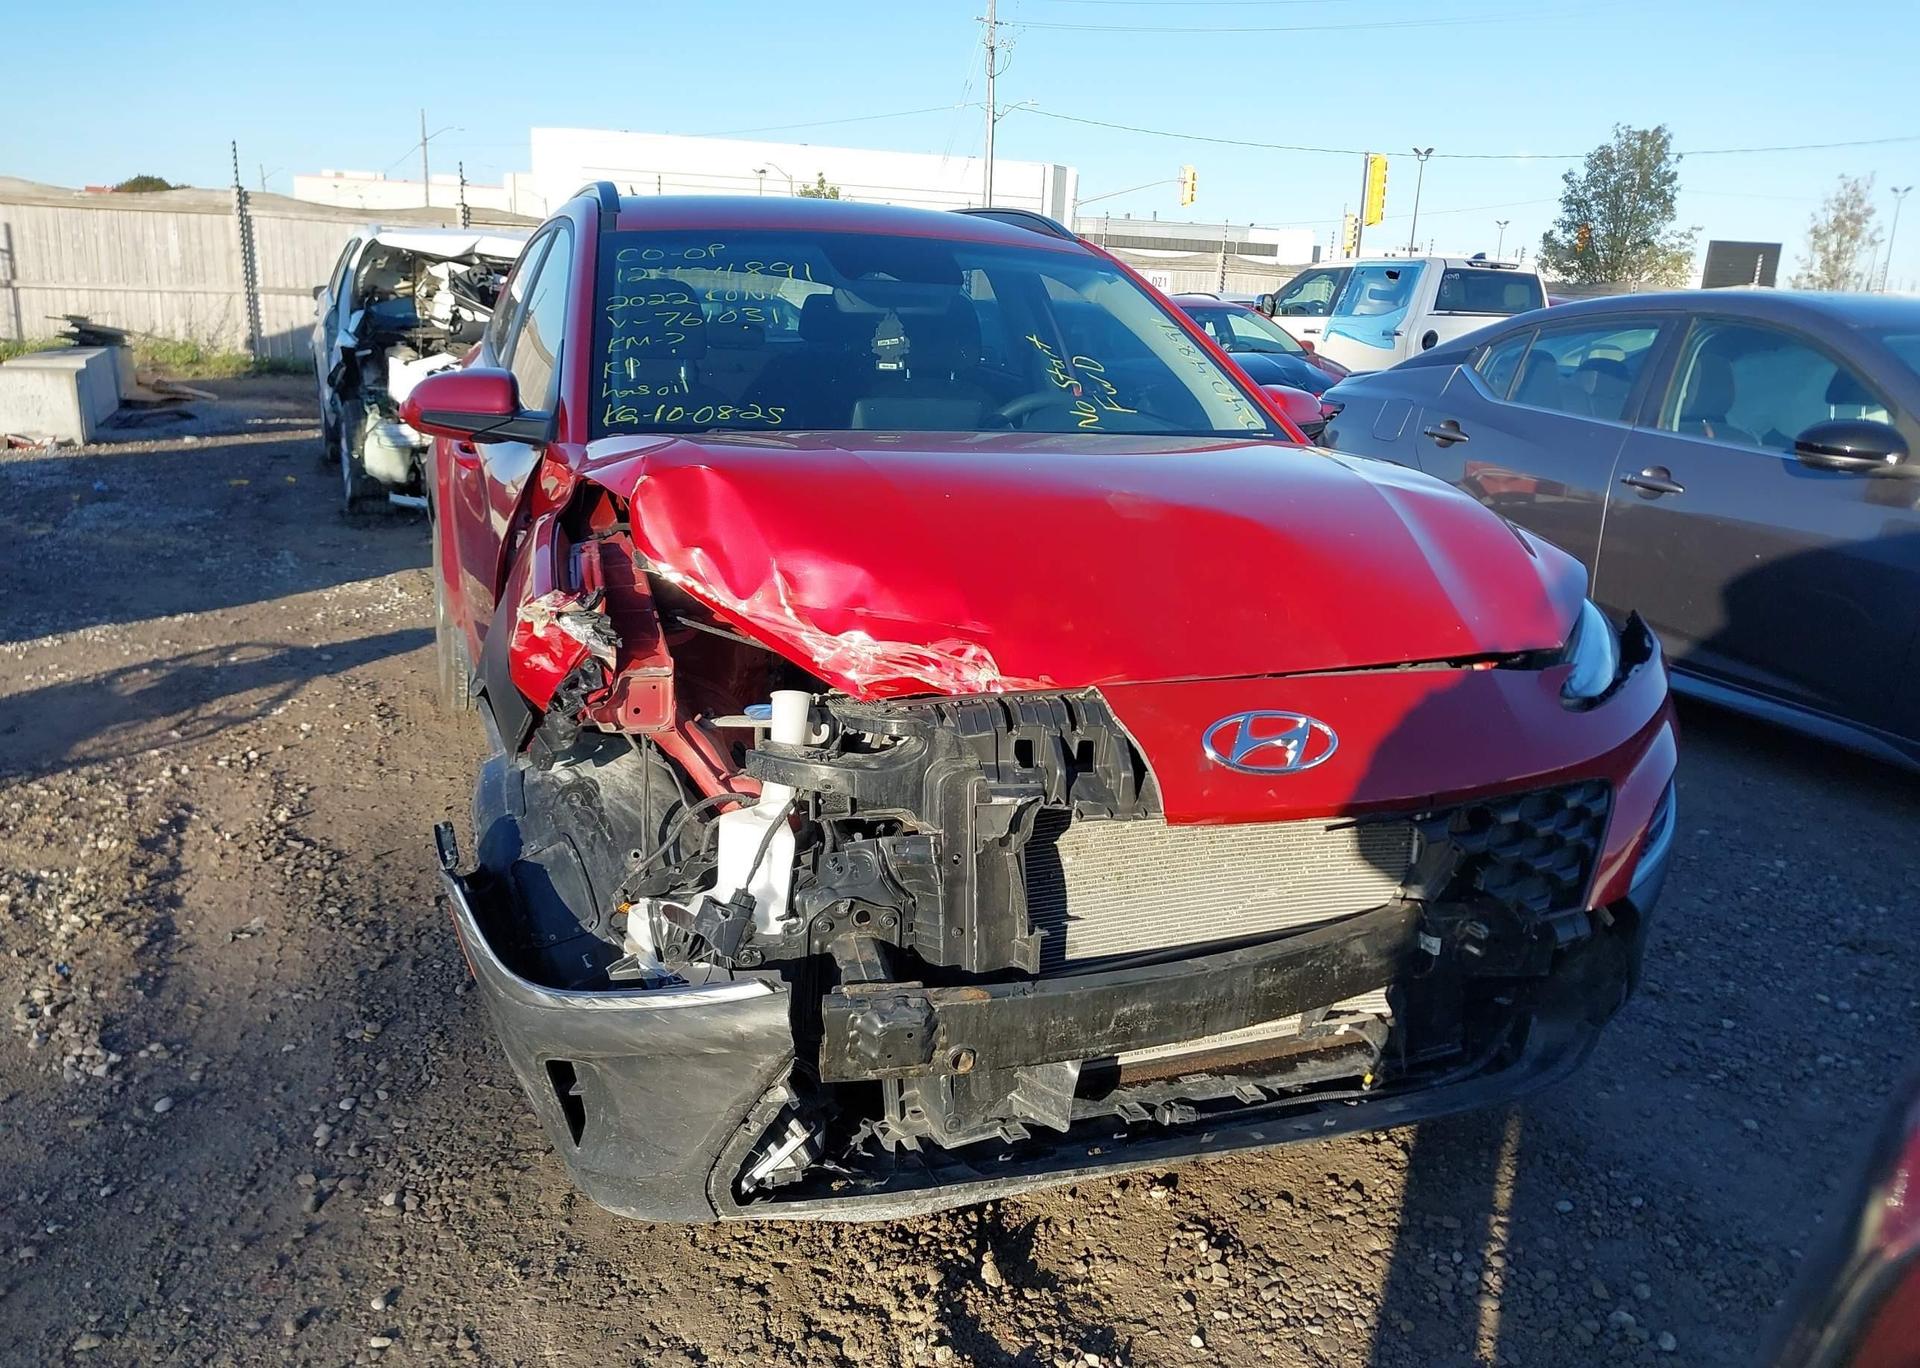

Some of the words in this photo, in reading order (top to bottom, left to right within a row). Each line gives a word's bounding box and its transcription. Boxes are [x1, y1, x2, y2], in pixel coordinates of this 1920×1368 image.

[616, 243, 726, 262] CO-OP
[617, 261, 813, 284] 1244891
[605, 292, 700, 312] 2022
